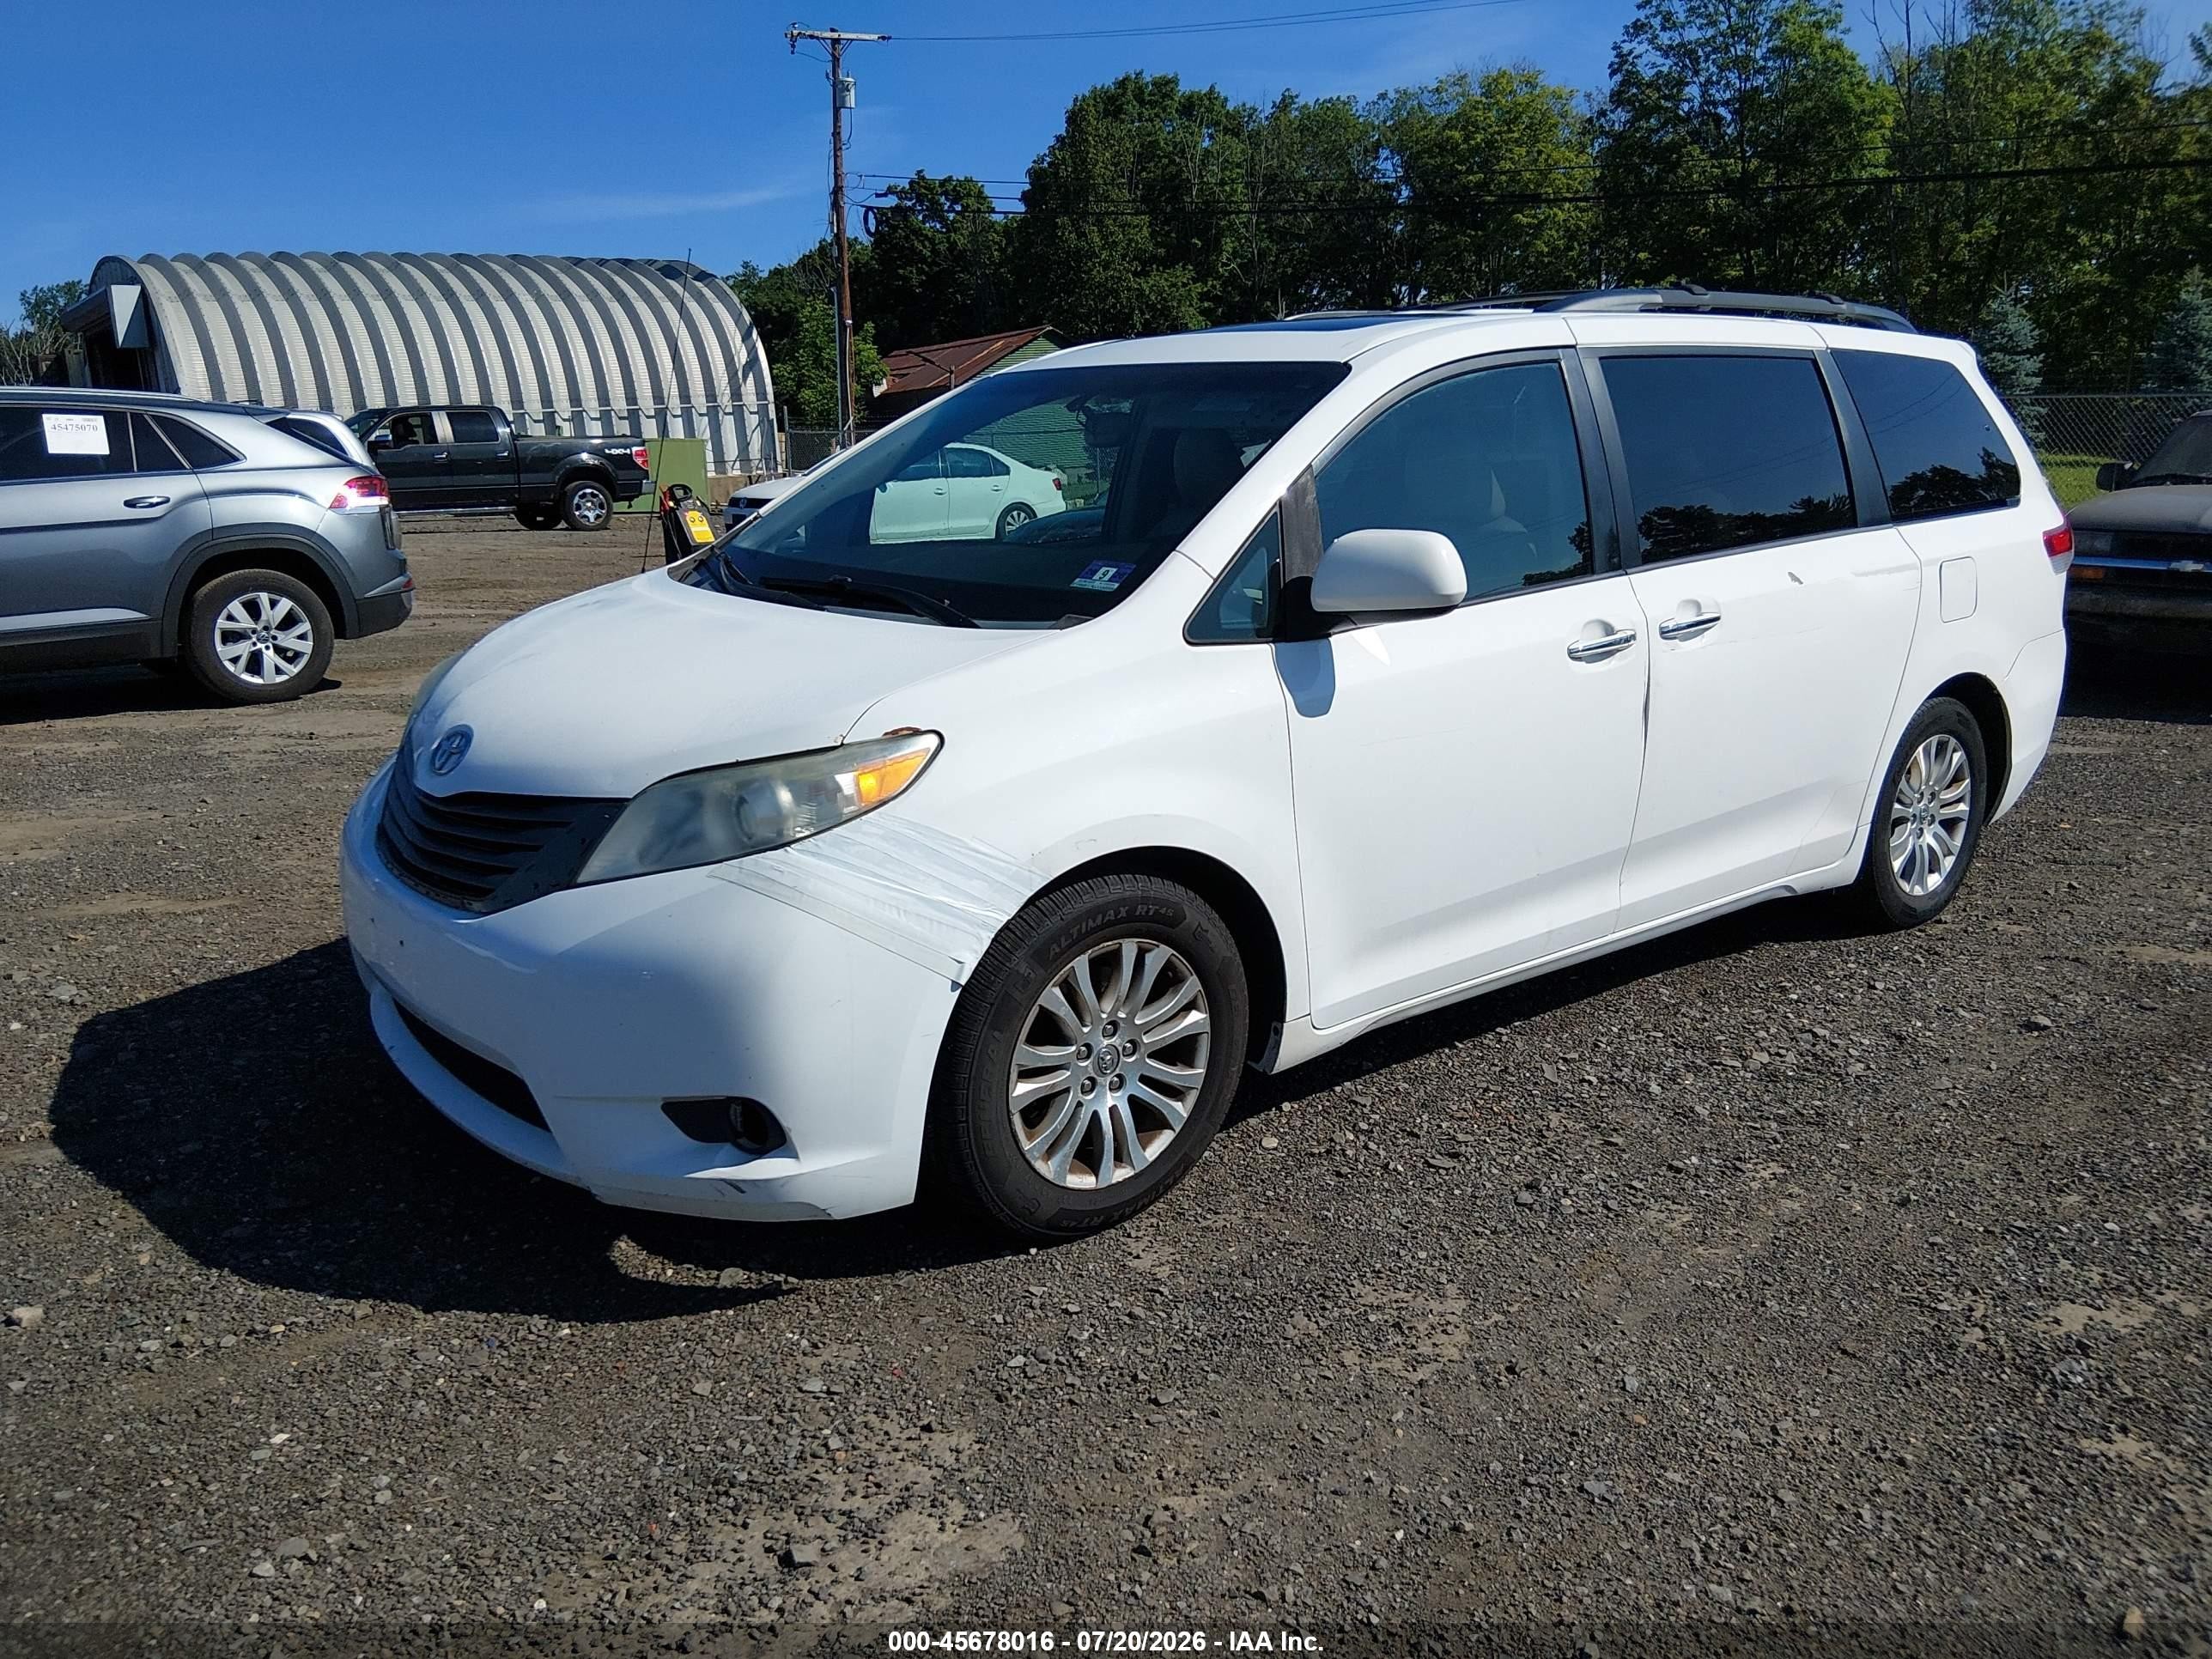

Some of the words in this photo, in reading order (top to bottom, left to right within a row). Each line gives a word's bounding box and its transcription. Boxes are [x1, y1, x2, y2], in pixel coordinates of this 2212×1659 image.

[50, 423, 99, 432] 45475070
[1098, 568, 1111, 580] 9
[1048, 906, 1128, 961] ALTIMAX
